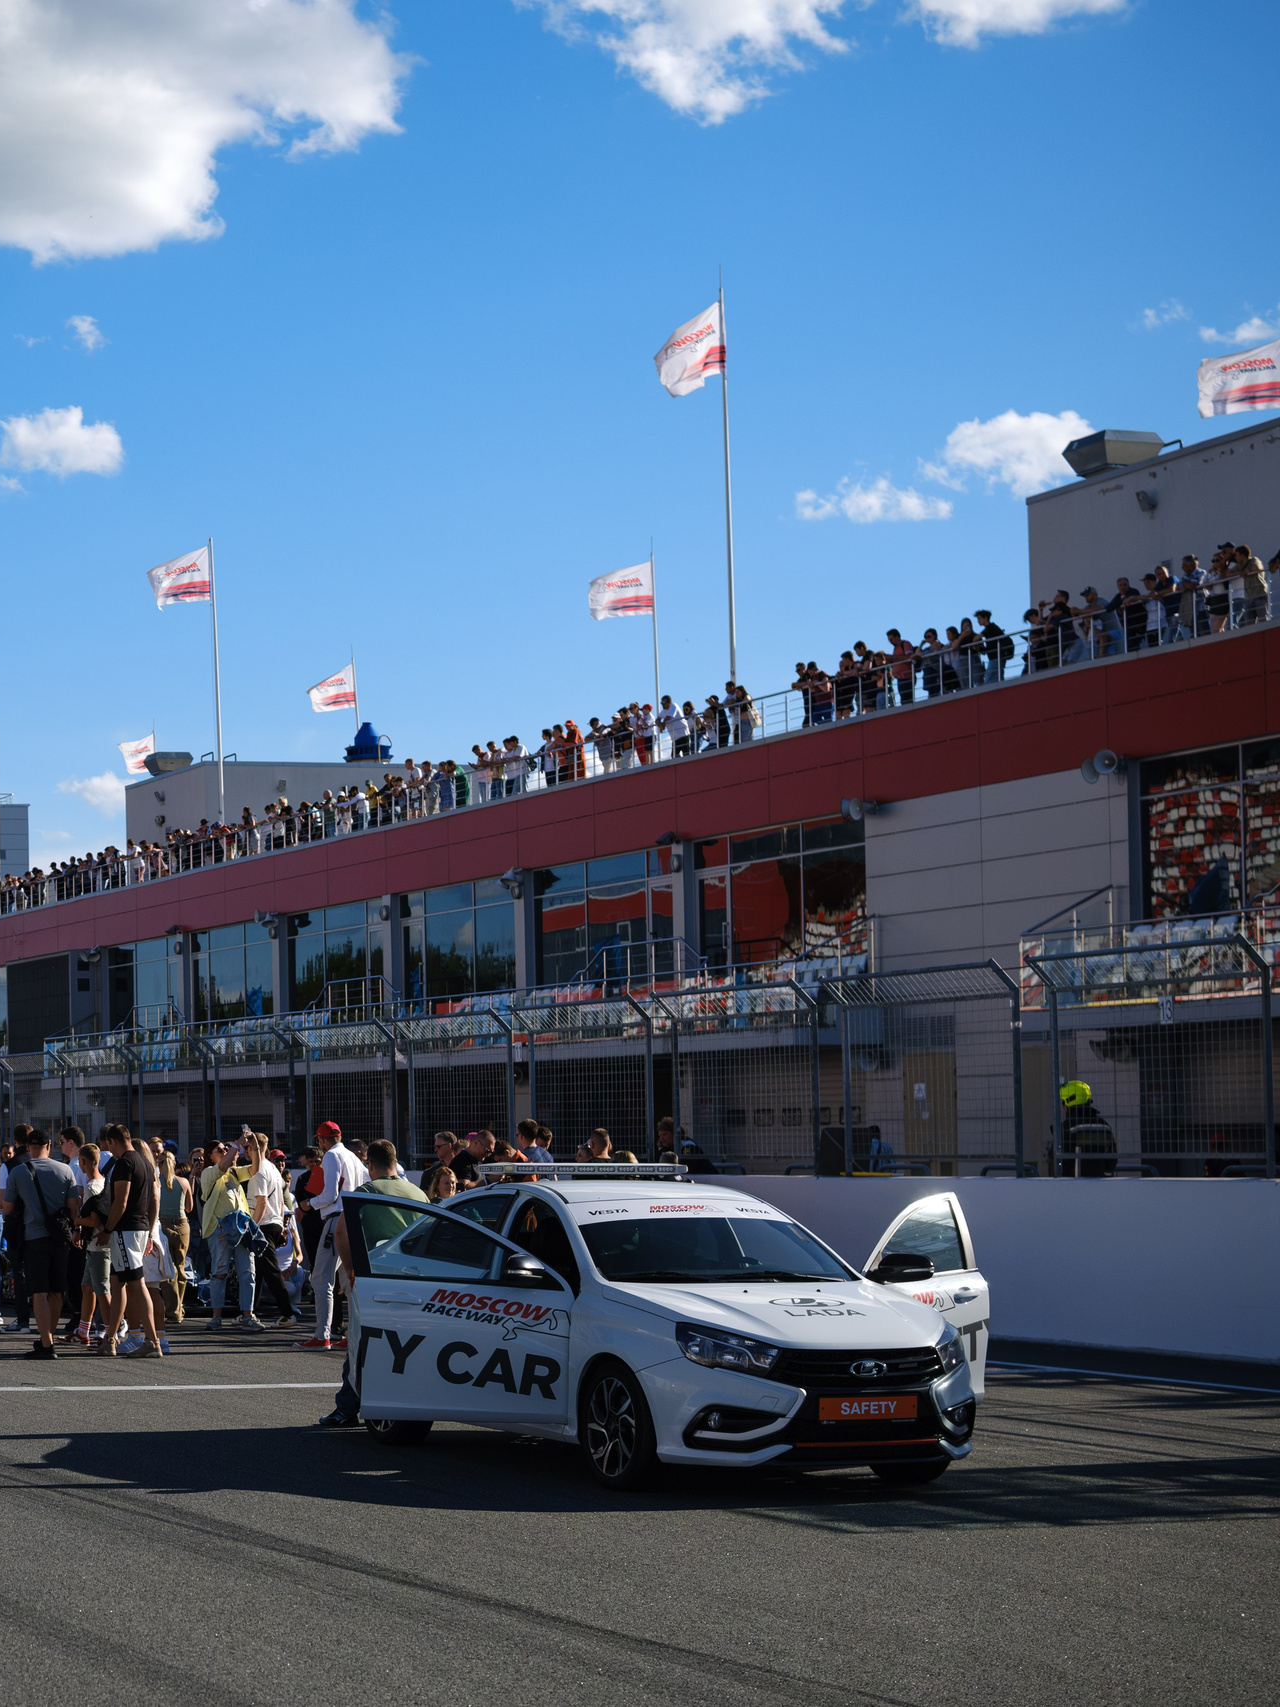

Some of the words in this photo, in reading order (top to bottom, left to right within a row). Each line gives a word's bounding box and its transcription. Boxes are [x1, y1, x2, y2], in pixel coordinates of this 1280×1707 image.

[1160, 1000, 1173, 1020] 13
[588, 1208, 629, 1216] VESTA
[735, 1207, 771, 1215] VESTA
[429, 1288, 552, 1321] MOSCOW
[783, 1309, 866, 1317] LADA
[421, 1303, 505, 1325] RACEWAY
[436, 1341, 562, 1400] CAR
[841, 1401, 897, 1415] SAFETY
